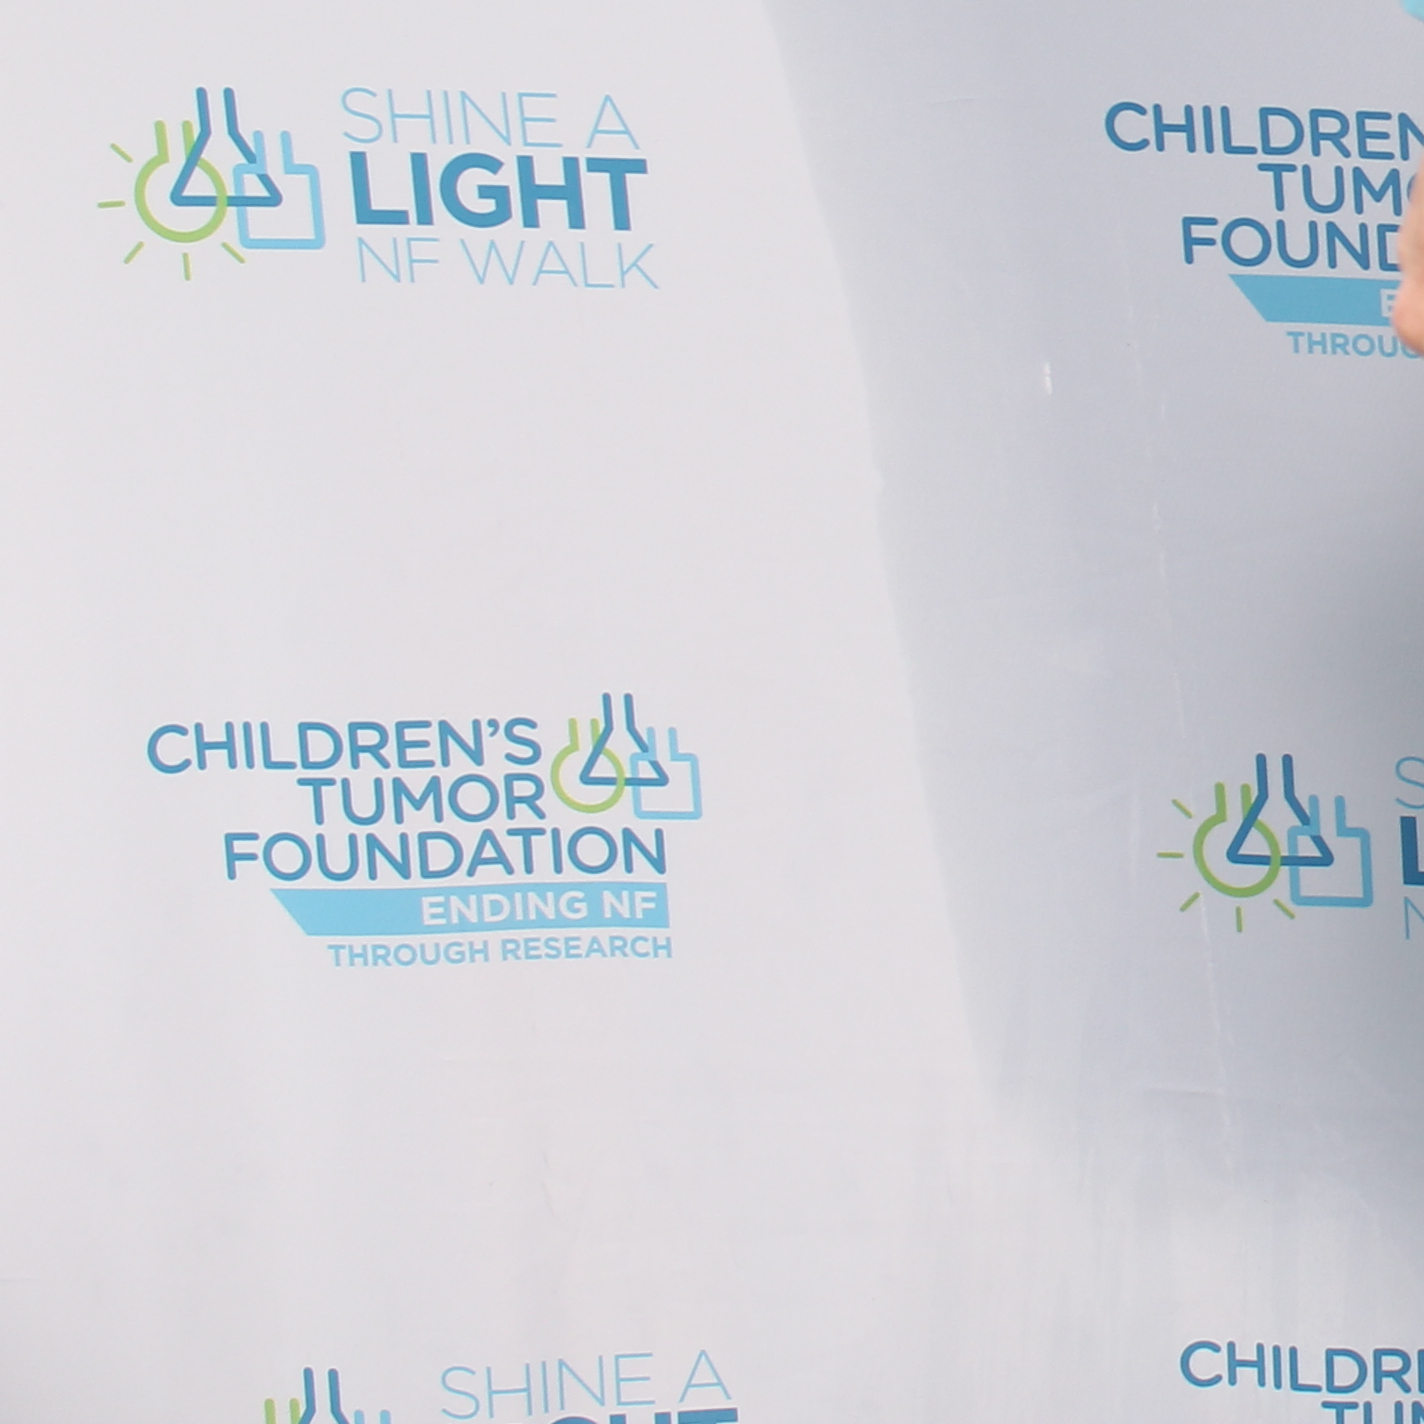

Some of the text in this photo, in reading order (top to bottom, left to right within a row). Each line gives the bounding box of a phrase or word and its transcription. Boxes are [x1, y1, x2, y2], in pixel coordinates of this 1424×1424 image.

[340, 87, 640, 150] SHINE A
[349, 151, 648, 231] LIGHT
[1257, 163, 1416, 217] TUM
[357, 236, 660, 290] NF WALK
[147, 717, 542, 774] CHILDREN'S
[296, 773, 546, 826] TUMOR
[224, 827, 666, 882] FOUNDATION
[421, 890, 658, 926] ENDING NF
[327, 936, 673, 968] THROUGH RESEARCH
[441, 1349, 732, 1420] SHINE A
